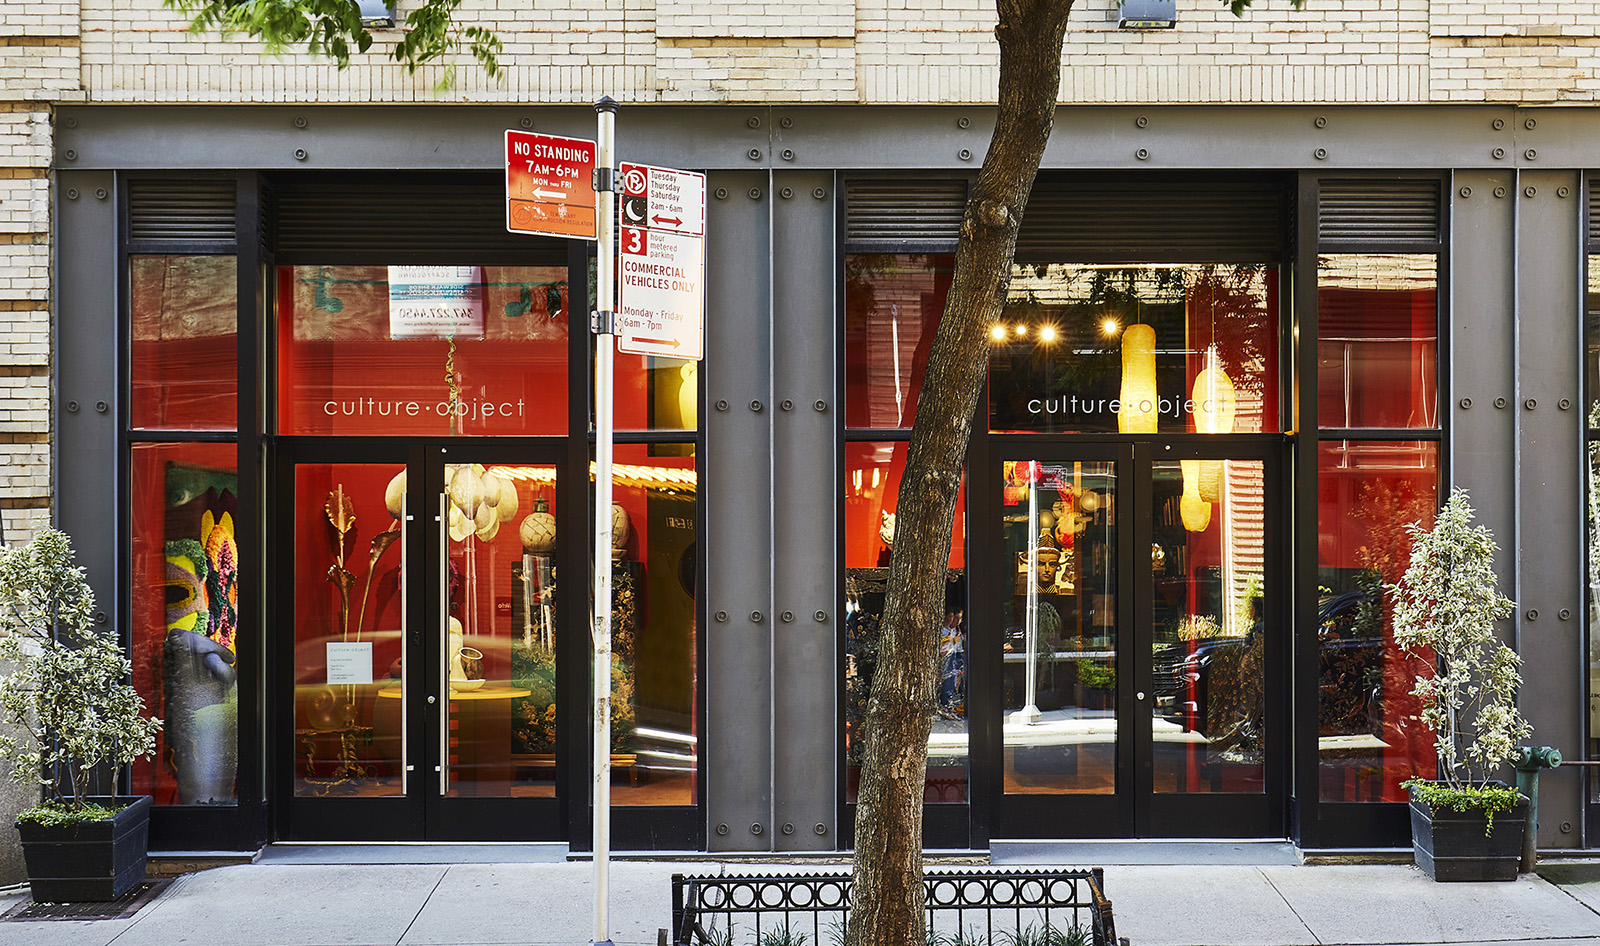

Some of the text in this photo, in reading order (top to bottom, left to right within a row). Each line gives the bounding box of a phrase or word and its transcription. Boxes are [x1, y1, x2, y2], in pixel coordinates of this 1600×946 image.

[514, 141, 590, 163] NO STANDING
[525, 160, 579, 179] 7AM-6PM
[533, 177, 549, 187] MON
[560, 180, 572, 189] FRI
[651, 171, 677, 184] Tuesday
[651, 180, 681, 192] Thursday
[650, 190, 680, 203] Saturday
[650, 201, 665, 211] 2am
[669, 203, 683, 213] 6am
[627, 228, 642, 253] 3
[650, 233, 665, 242] hour
[650, 242, 678, 252] metered
[650, 250, 675, 262] parking
[624, 260, 686, 279] COMMERCIAL
[624, 275, 696, 293] VEHICLES ONLY
[624, 306, 654, 319] Monday
[661, 310, 684, 323] Friday
[624, 318, 641, 328] 6am
[647, 319, 663, 331] 7pm
